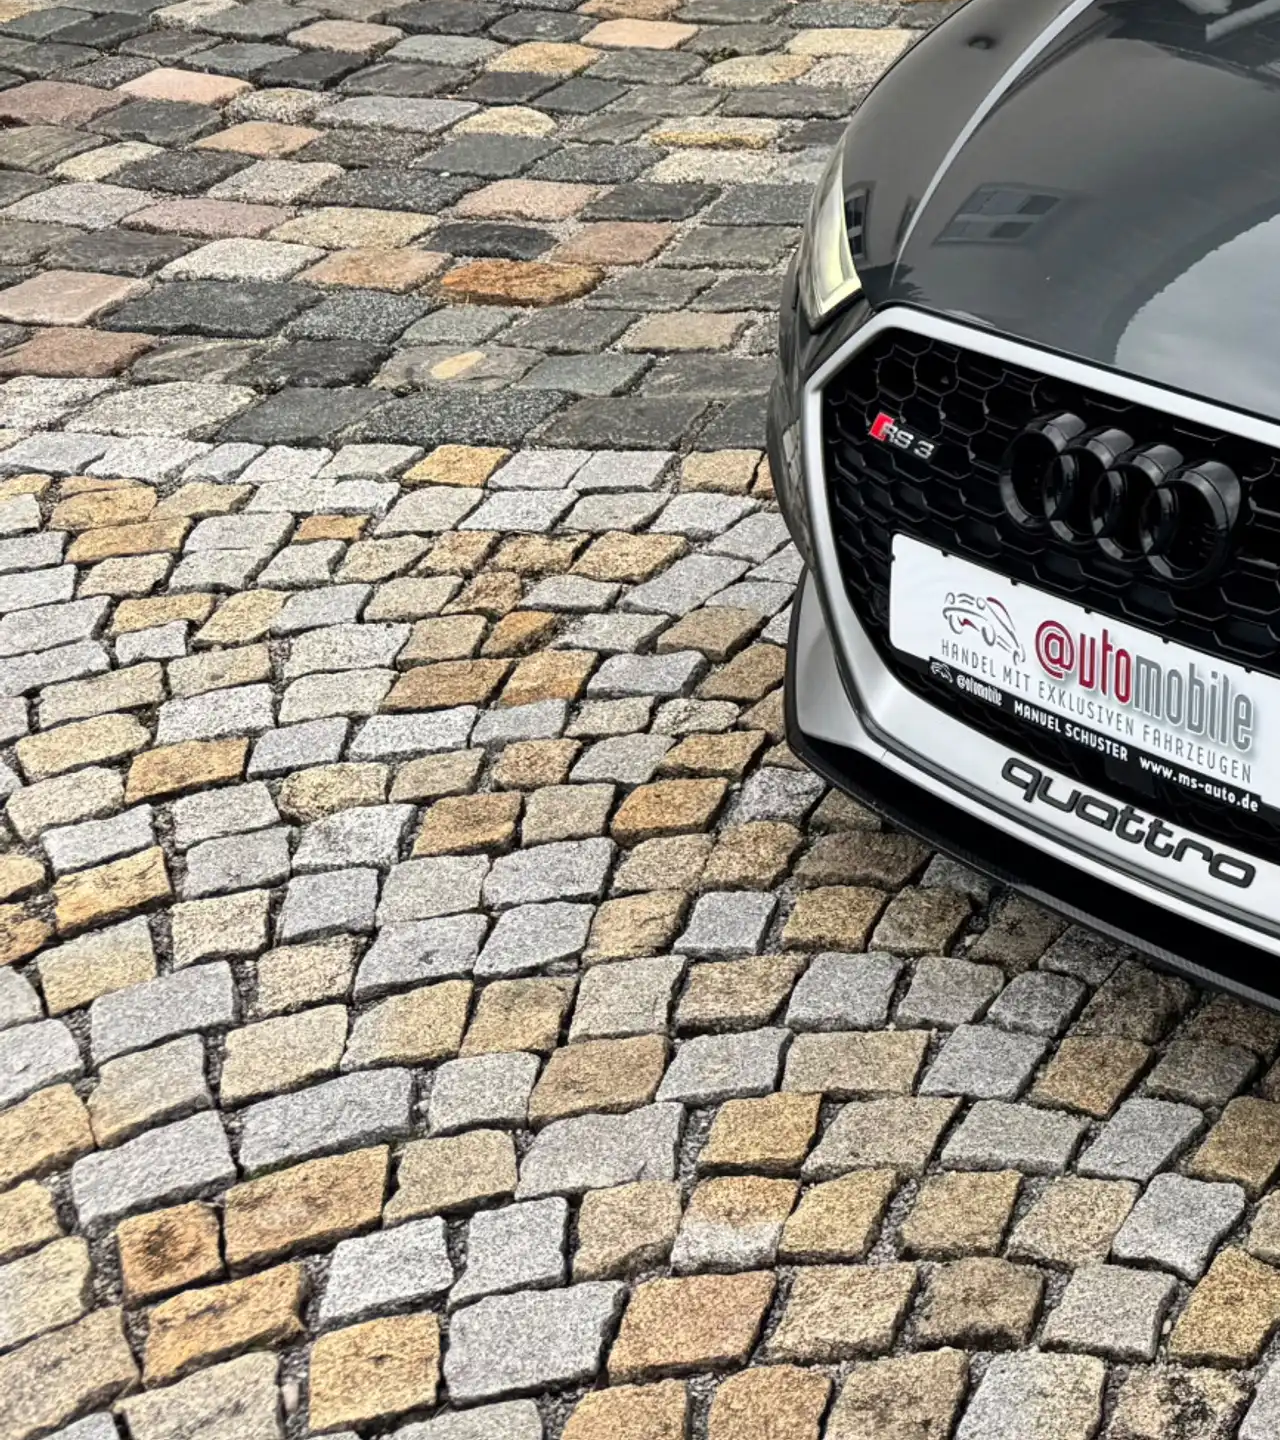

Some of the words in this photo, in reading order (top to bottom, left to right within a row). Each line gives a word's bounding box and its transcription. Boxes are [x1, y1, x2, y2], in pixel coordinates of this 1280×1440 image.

[941, 638, 996, 678] HANDEL
[1003, 665, 1031, 692] MIT
[1143, 724, 1251, 784] FAHRZEUGEN
[1035, 620, 1253, 752] @utomobile
[1014, 700, 1061, 733] MANUEL
[1065, 723, 1128, 762] SCHUSTER
[1139, 756, 1259, 812] www.ms-auto.de
[1001, 757, 1256, 889] quattro
